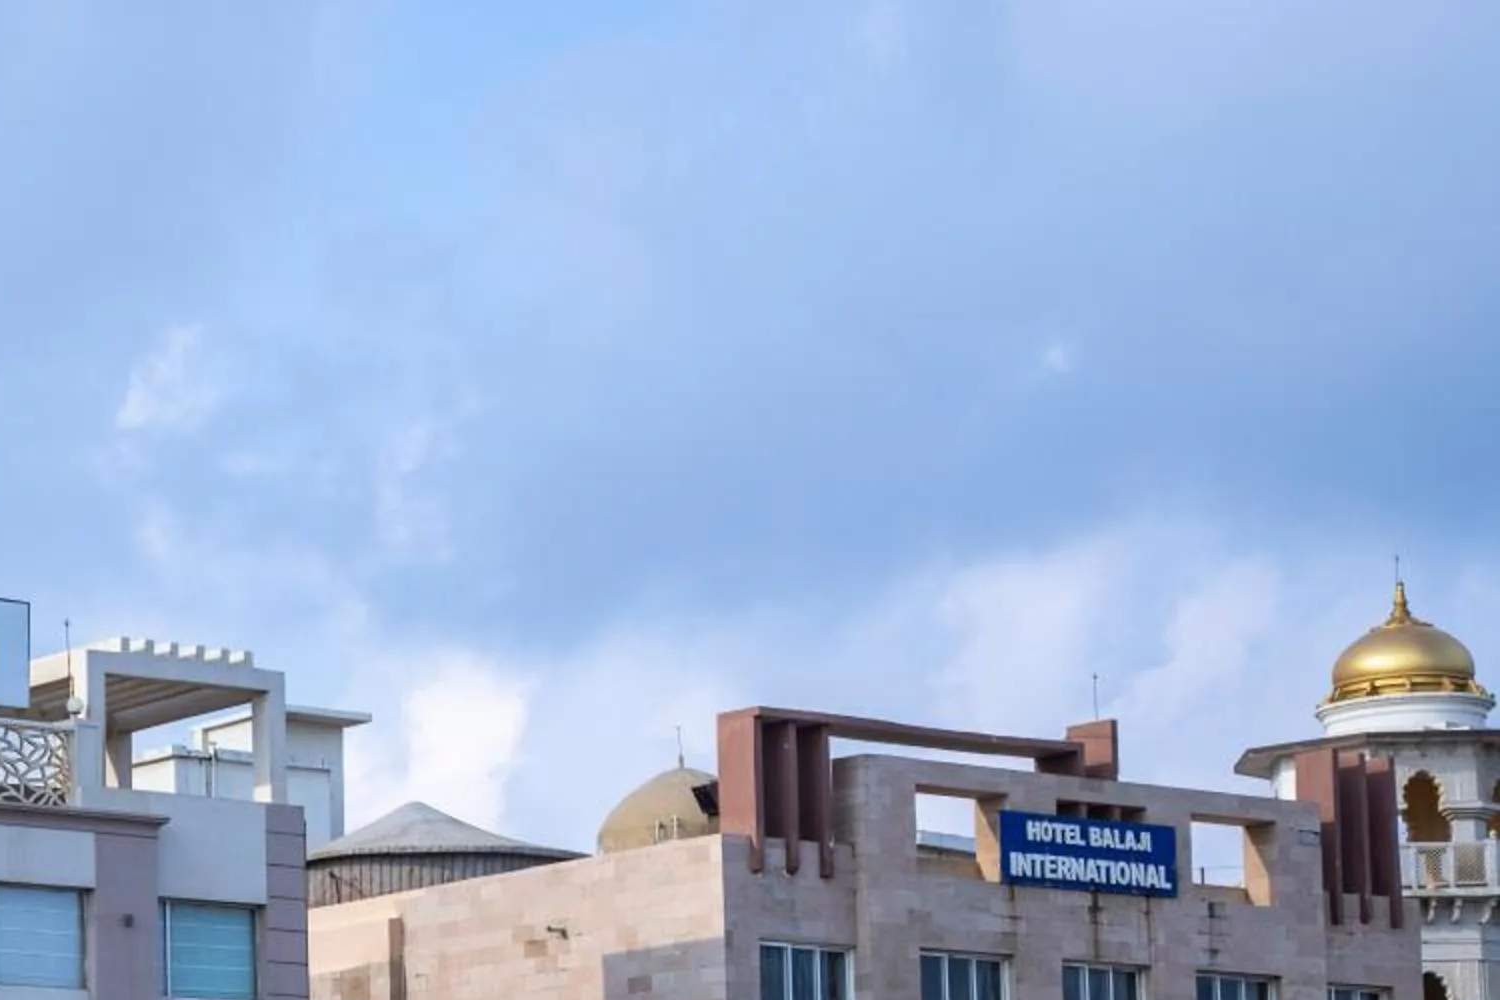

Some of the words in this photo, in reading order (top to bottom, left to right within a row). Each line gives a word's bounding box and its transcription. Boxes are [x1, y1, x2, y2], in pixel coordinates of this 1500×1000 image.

[1026, 820, 1086, 846] HOTEL
[1088, 826, 1153, 852] BALAJI
[1009, 851, 1172, 890] INTERNATIONAL
